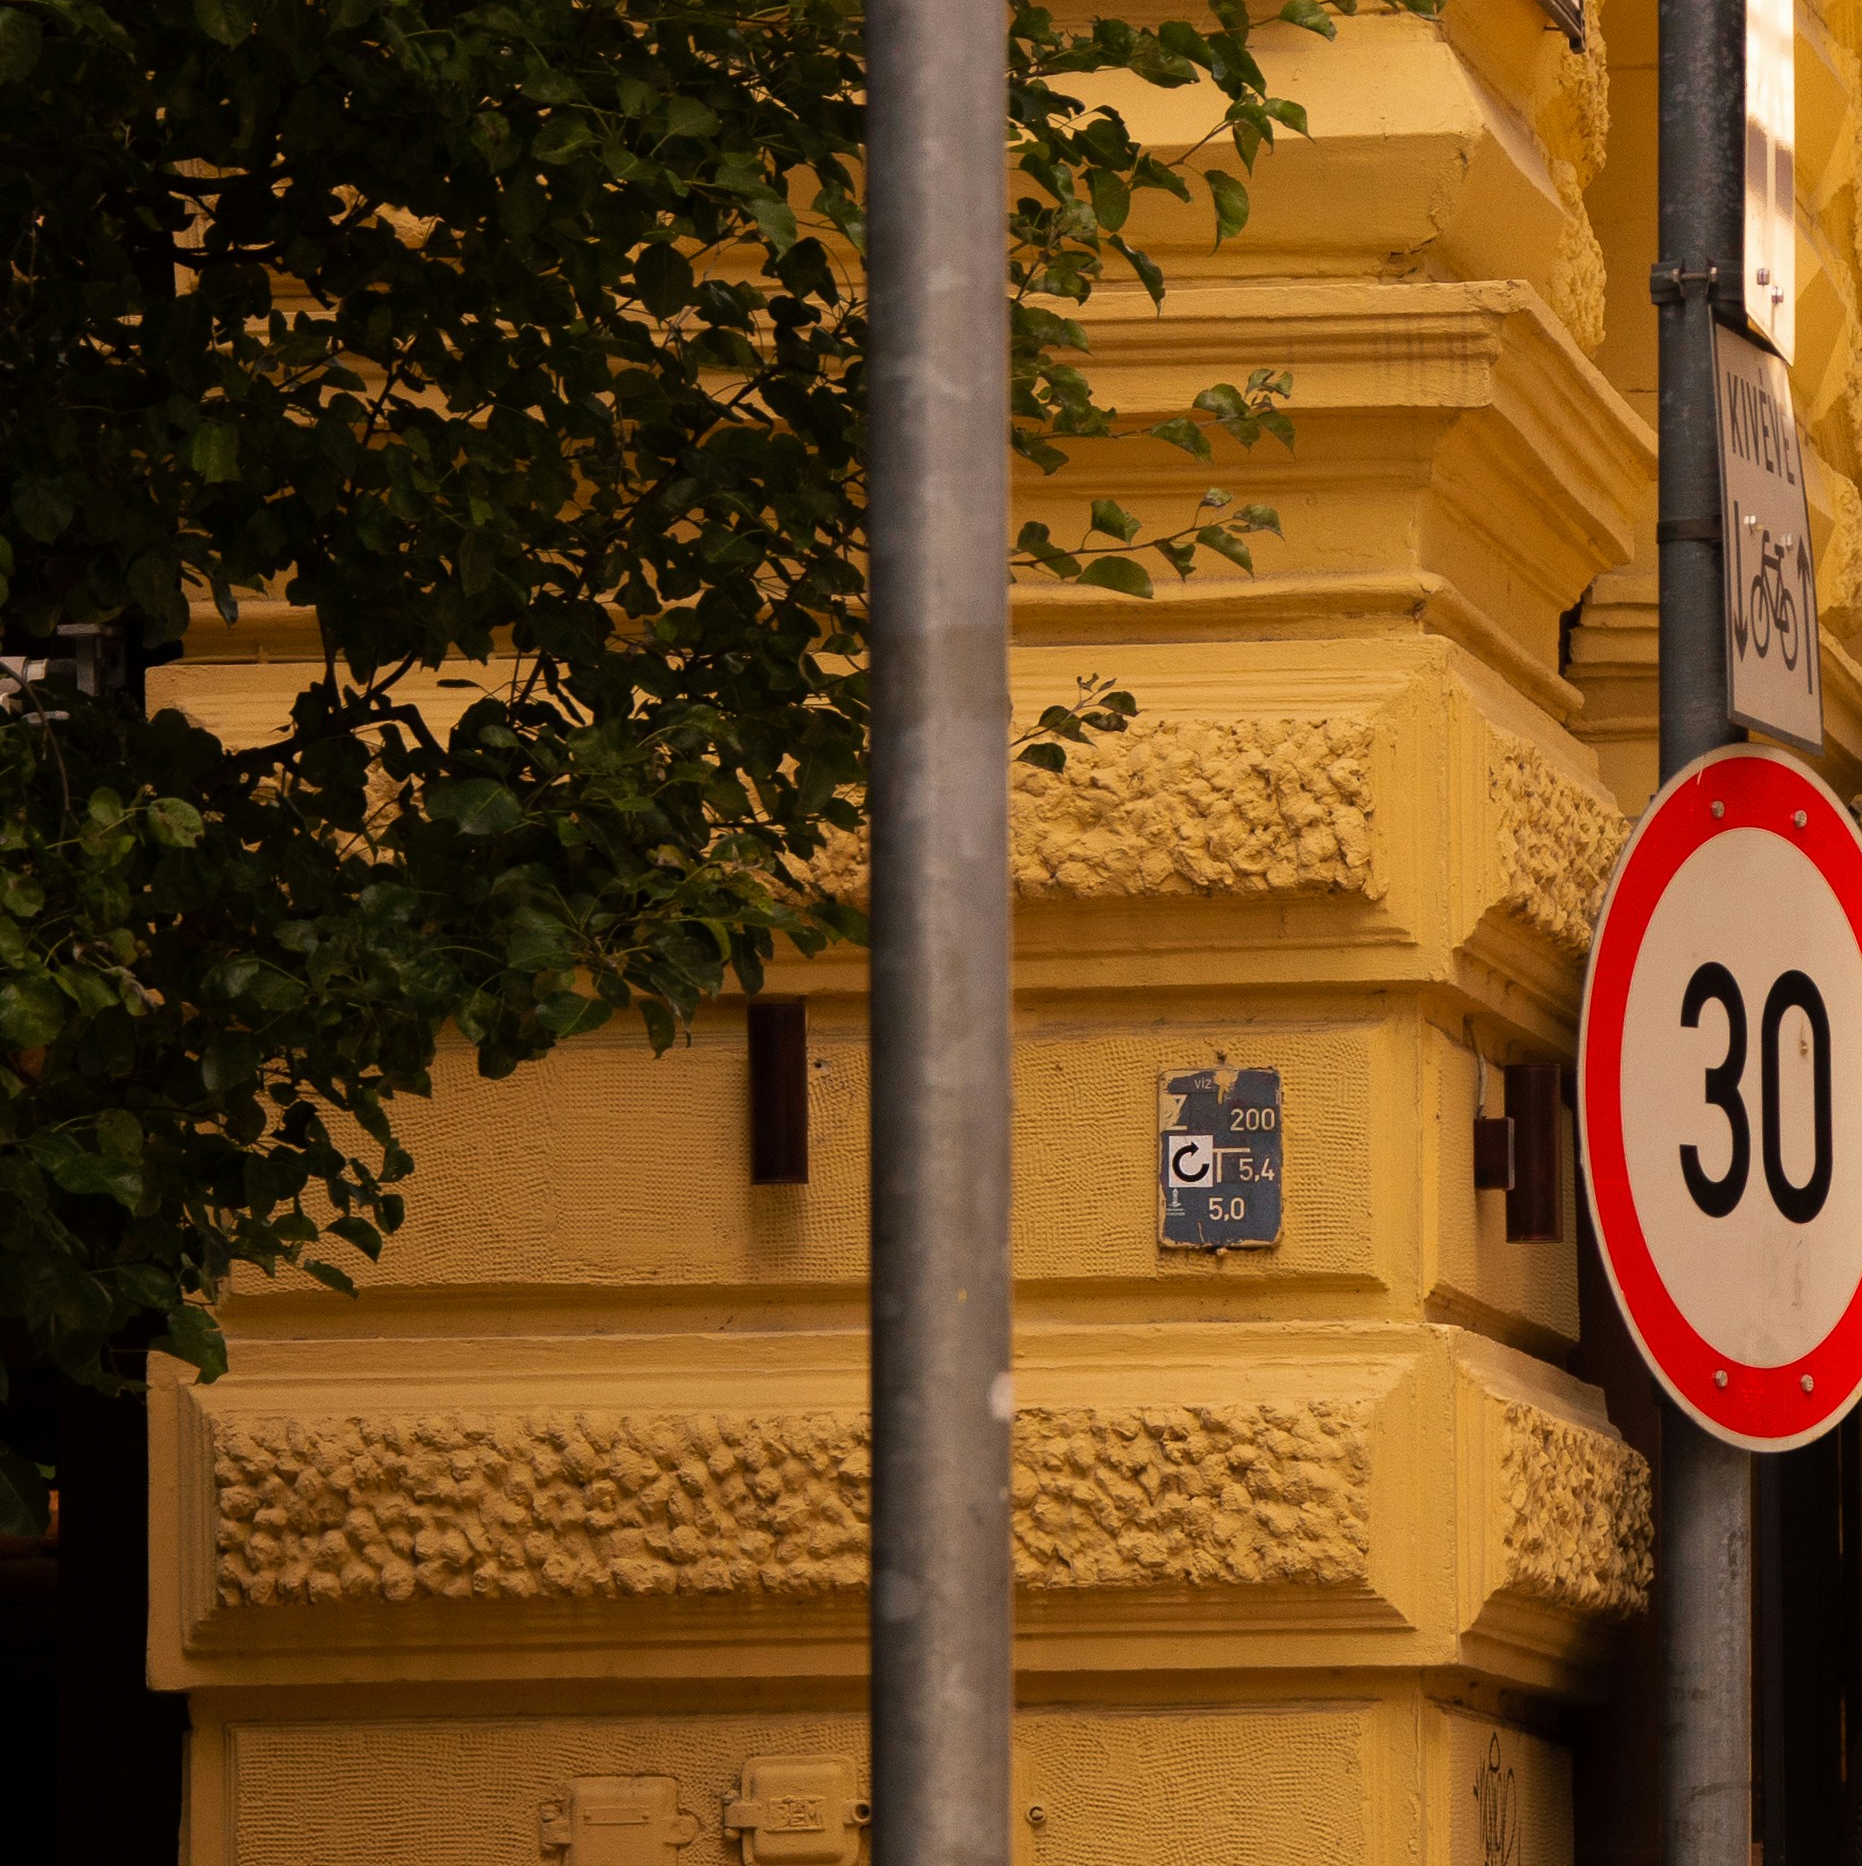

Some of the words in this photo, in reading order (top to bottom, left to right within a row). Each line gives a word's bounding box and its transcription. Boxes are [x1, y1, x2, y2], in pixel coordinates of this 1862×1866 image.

[1726, 367, 1796, 486] KIVÉVE
[1680, 961, 1832, 1224] 30
[1229, 1107, 1276, 1132] 200
[1238, 1158, 1275, 1182] 5,4
[1208, 1197, 1246, 1222] 5,0
